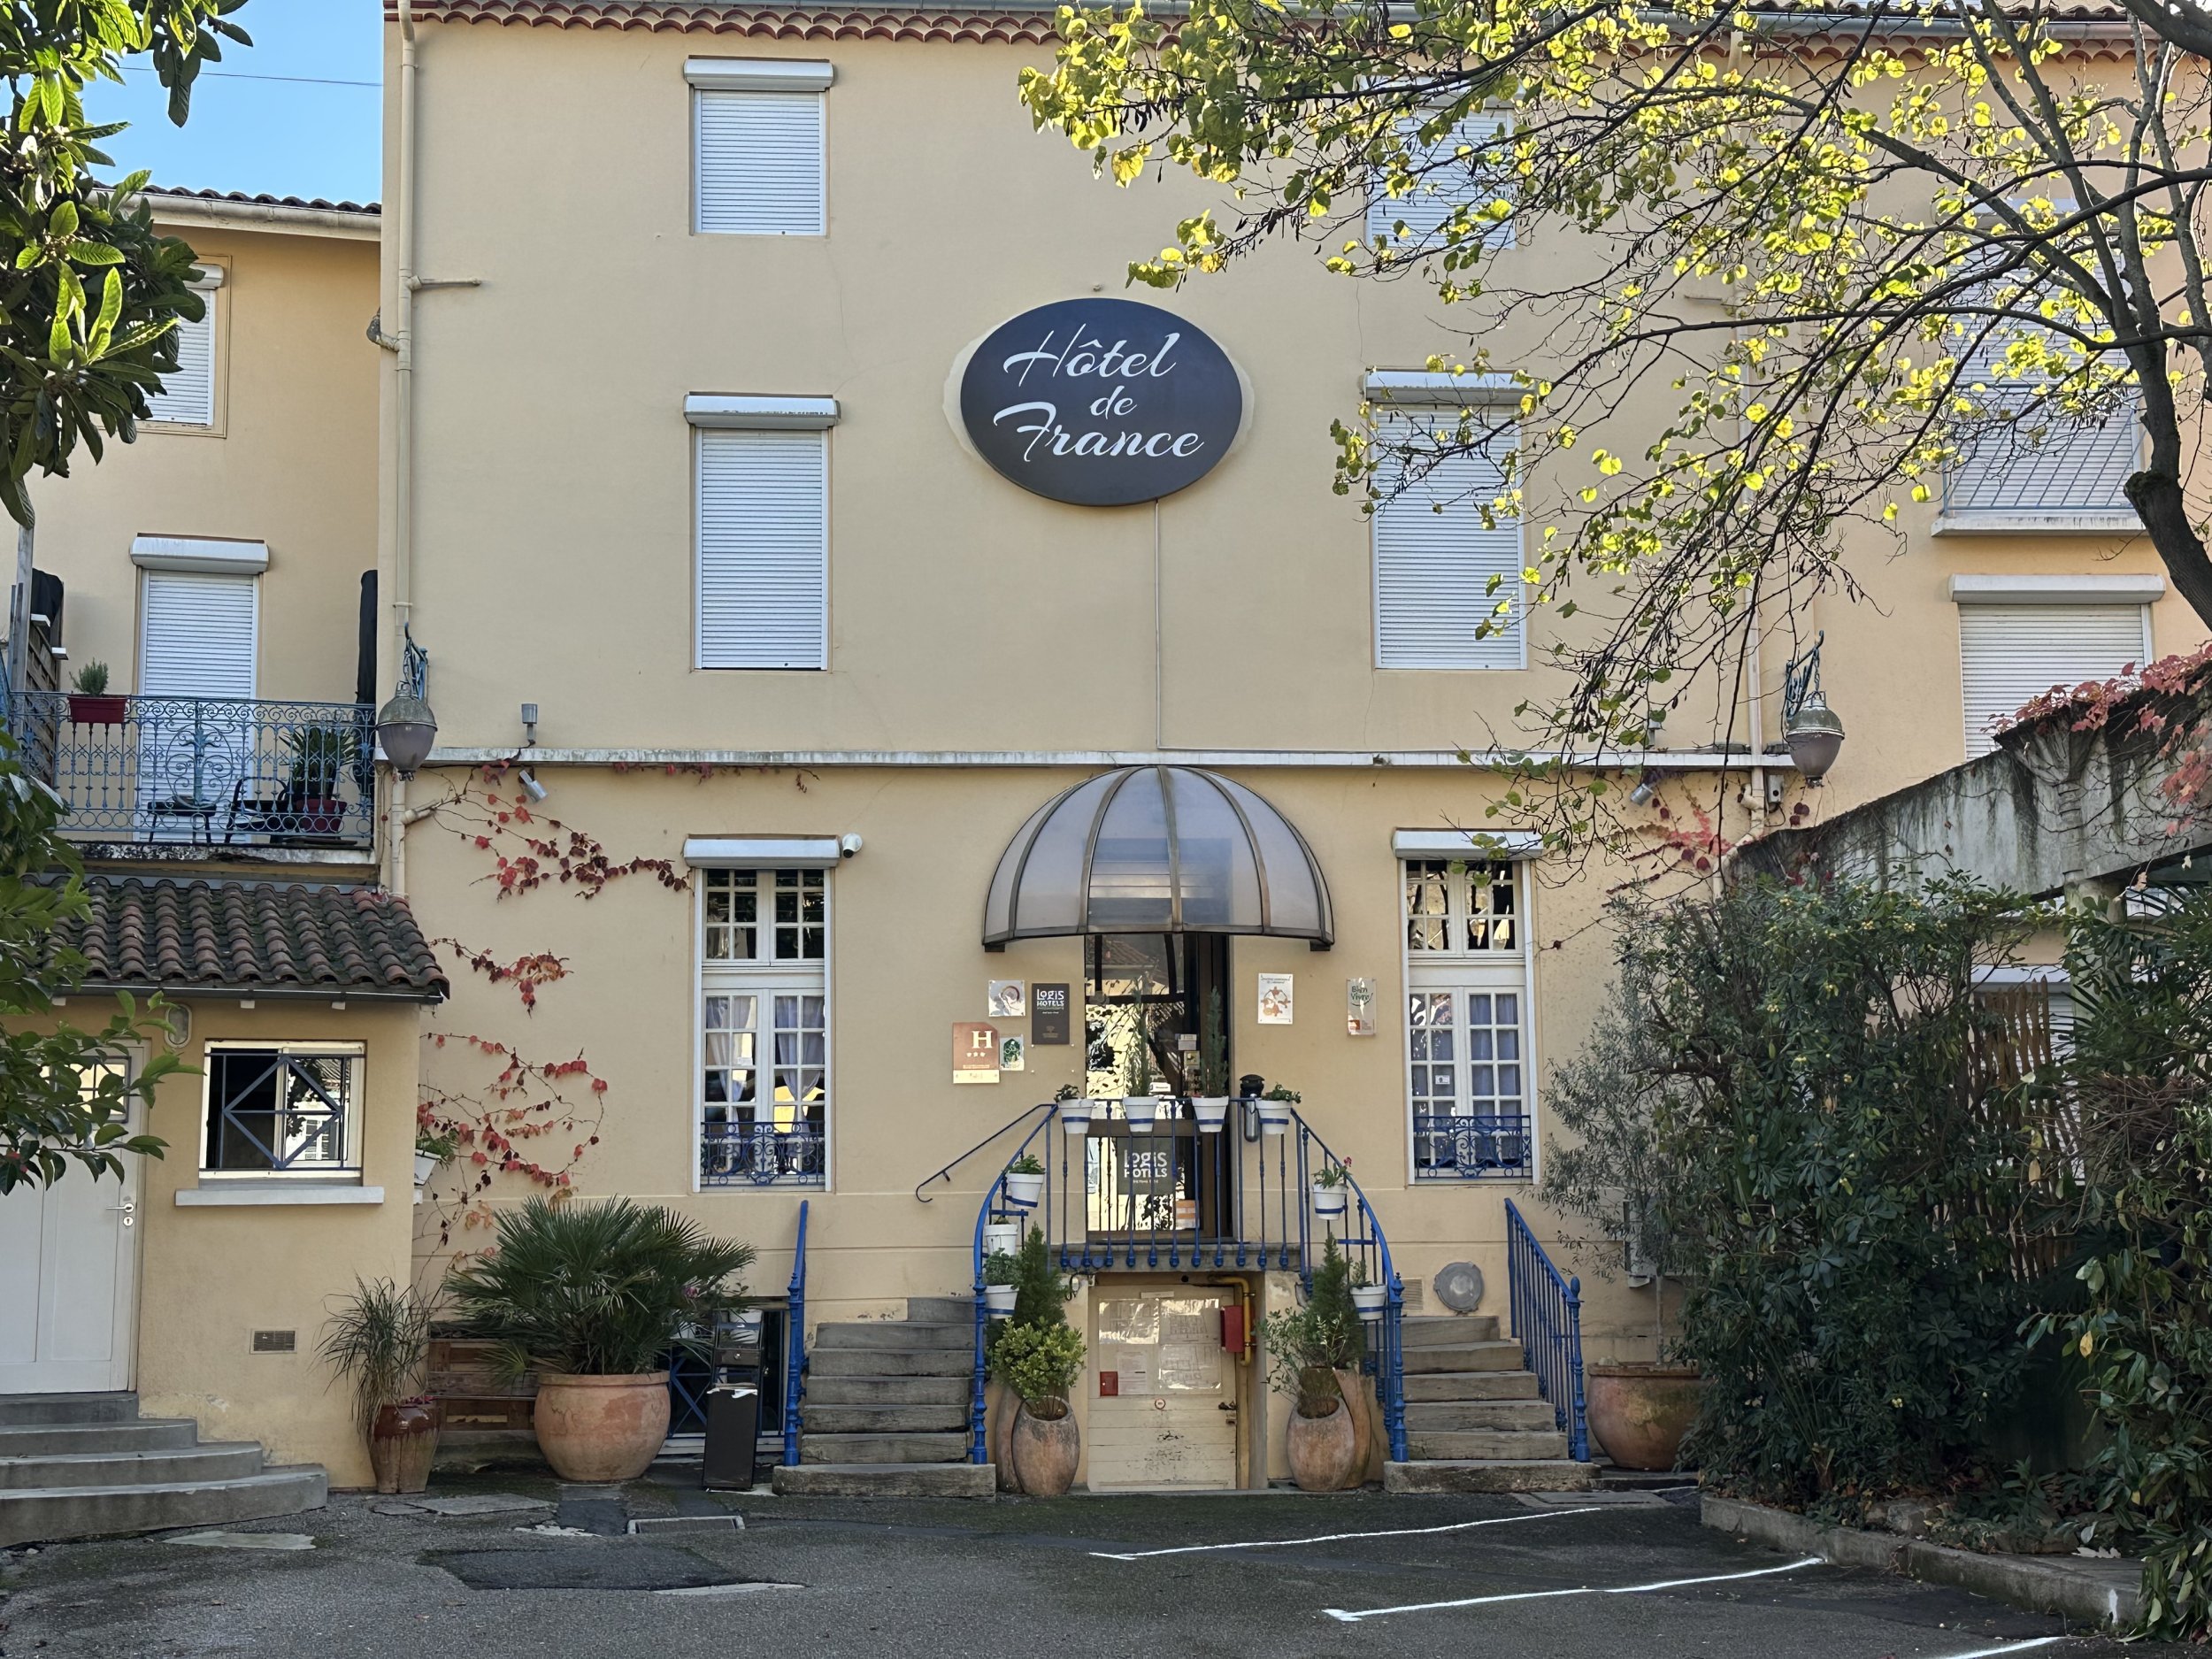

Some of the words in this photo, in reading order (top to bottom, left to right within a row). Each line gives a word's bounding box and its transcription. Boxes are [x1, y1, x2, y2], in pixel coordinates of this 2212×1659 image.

[1002, 323, 1180, 387] Hôtel
[1090, 385, 1138, 419] de
[993, 401, 1205, 462] France
[972, 1030, 993, 1048] H
